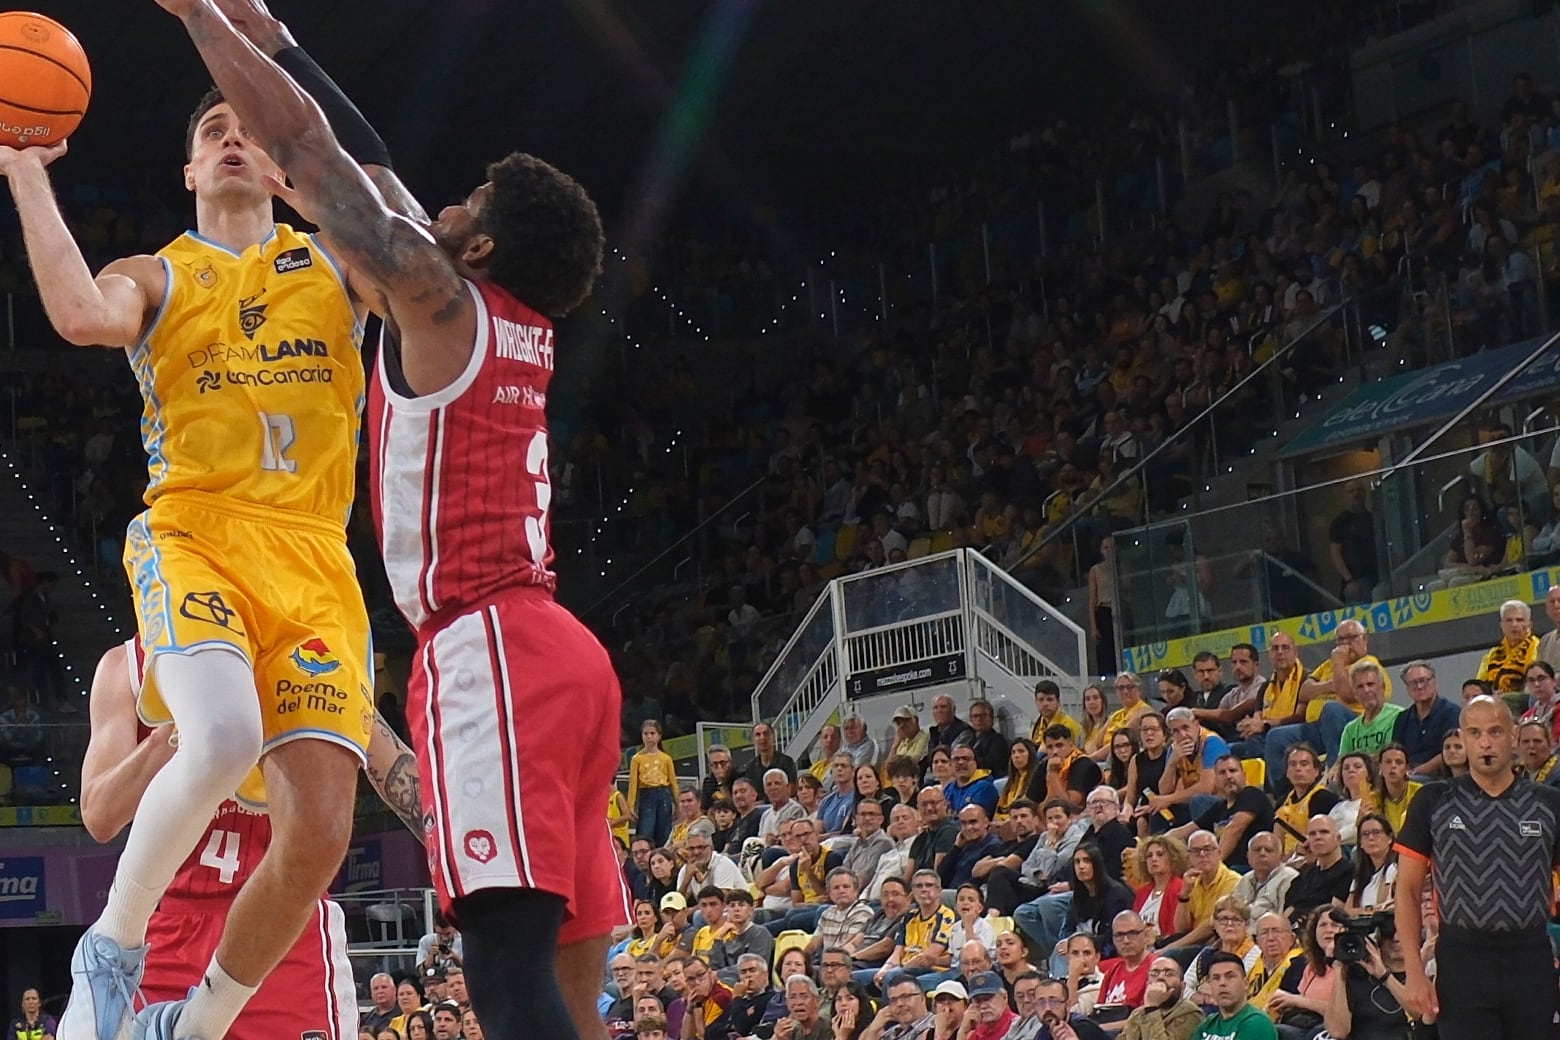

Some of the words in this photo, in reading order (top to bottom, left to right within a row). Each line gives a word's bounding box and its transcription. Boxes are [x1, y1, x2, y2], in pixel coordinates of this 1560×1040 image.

[24, 125, 51, 138] liga
[492, 316, 554, 372] WRIGHT-F
[492, 385, 520, 405] AIR
[276, 679, 348, 700] Poema
[277, 696, 301, 715] del
[307, 695, 346, 715] Mar
[200, 829, 240, 884] 4
